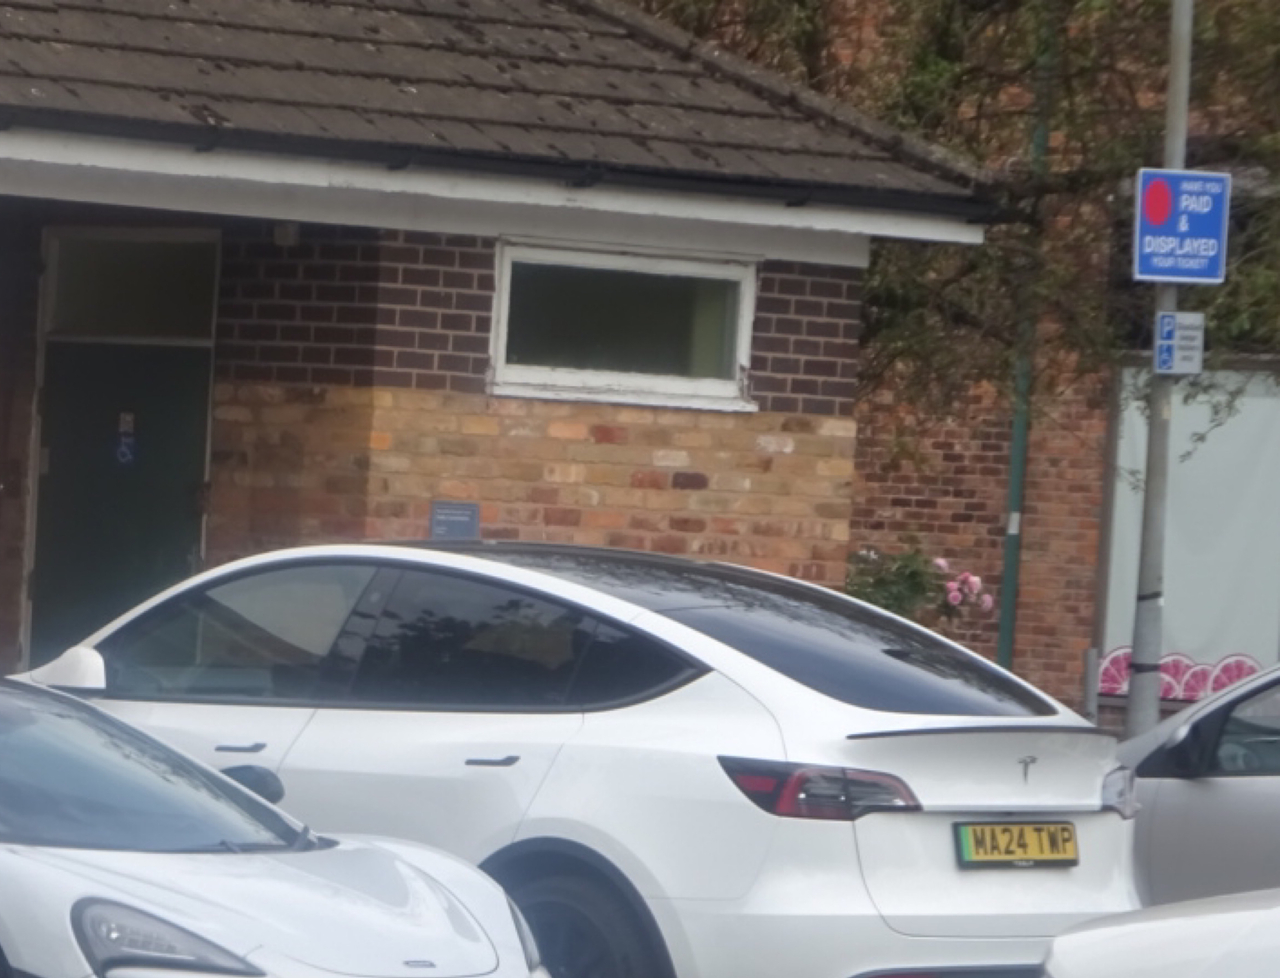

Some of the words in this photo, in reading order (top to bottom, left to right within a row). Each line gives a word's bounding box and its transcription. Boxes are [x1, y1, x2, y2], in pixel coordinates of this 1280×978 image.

[1180, 194, 1213, 212] PAID
[1178, 214, 1190, 232] &
[1143, 235, 1219, 257] DISPLAYED
[972, 827, 1028, 855] MA24
